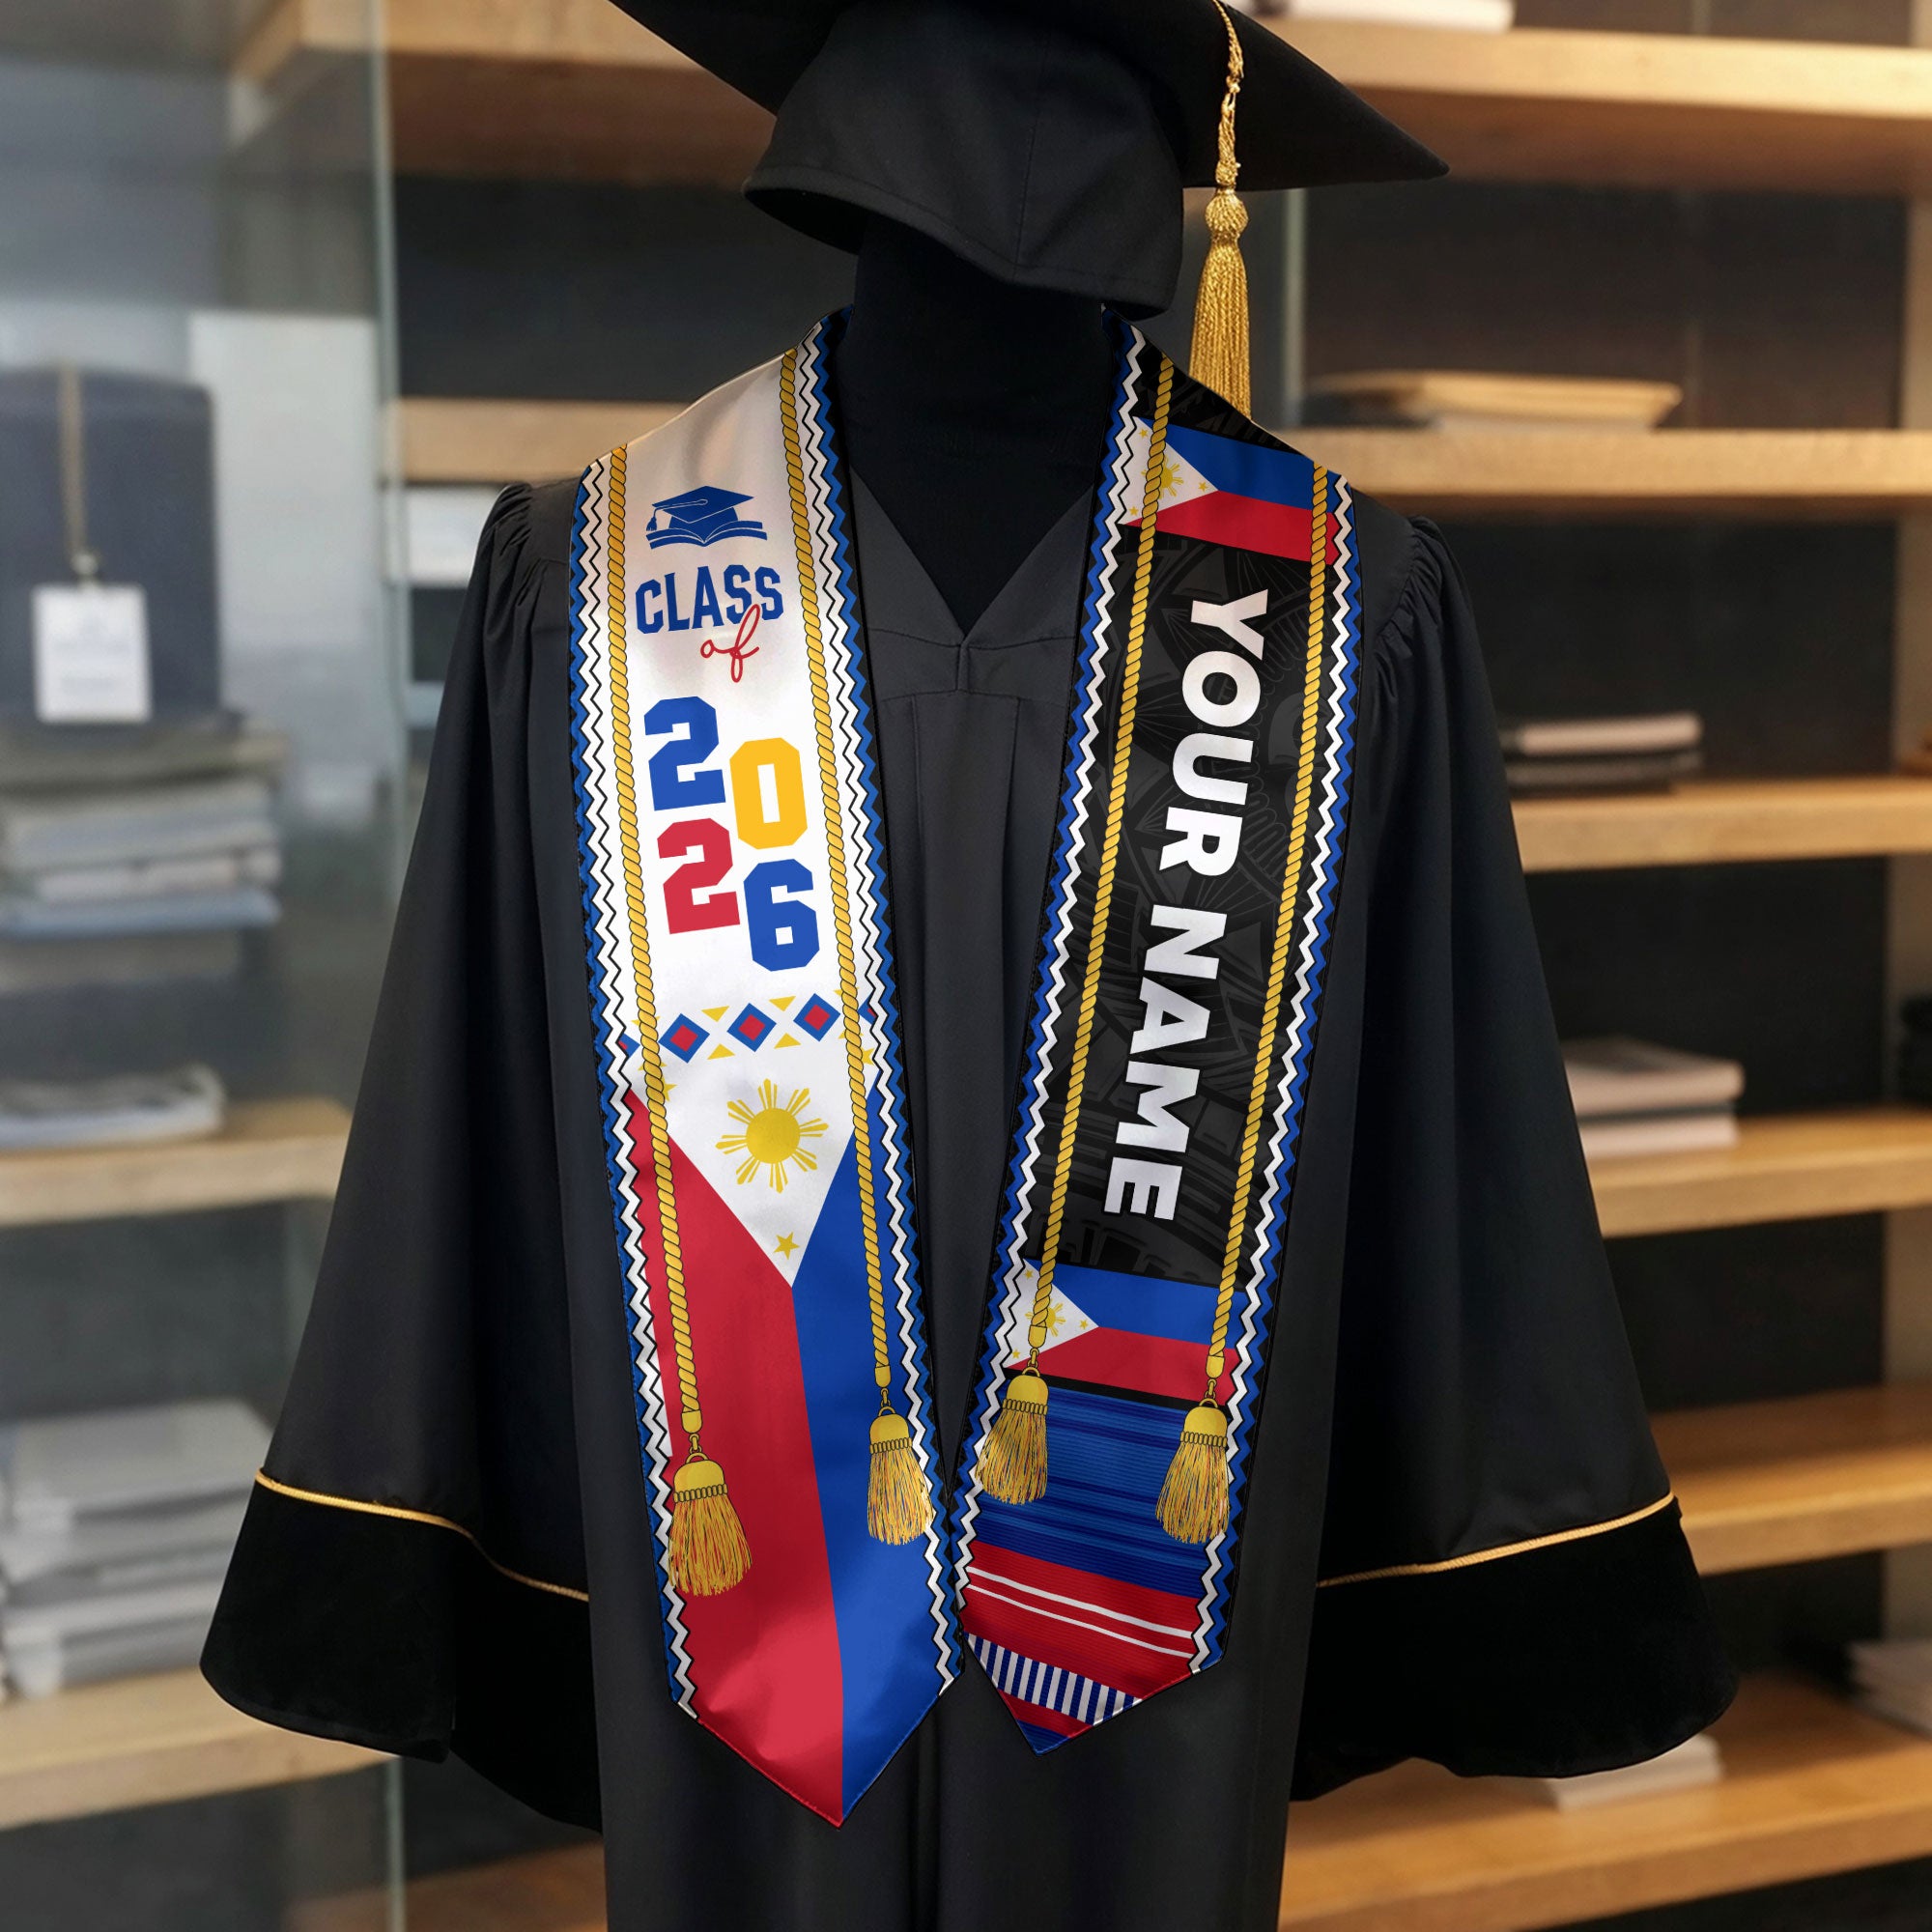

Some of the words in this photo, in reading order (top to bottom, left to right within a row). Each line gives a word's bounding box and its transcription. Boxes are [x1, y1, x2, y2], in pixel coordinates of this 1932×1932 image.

[636, 565, 783, 634] CLASS
[700, 604, 760, 683] of
[1159, 588, 1269, 876] YOUR
[1104, 905, 1227, 1221] NAME
